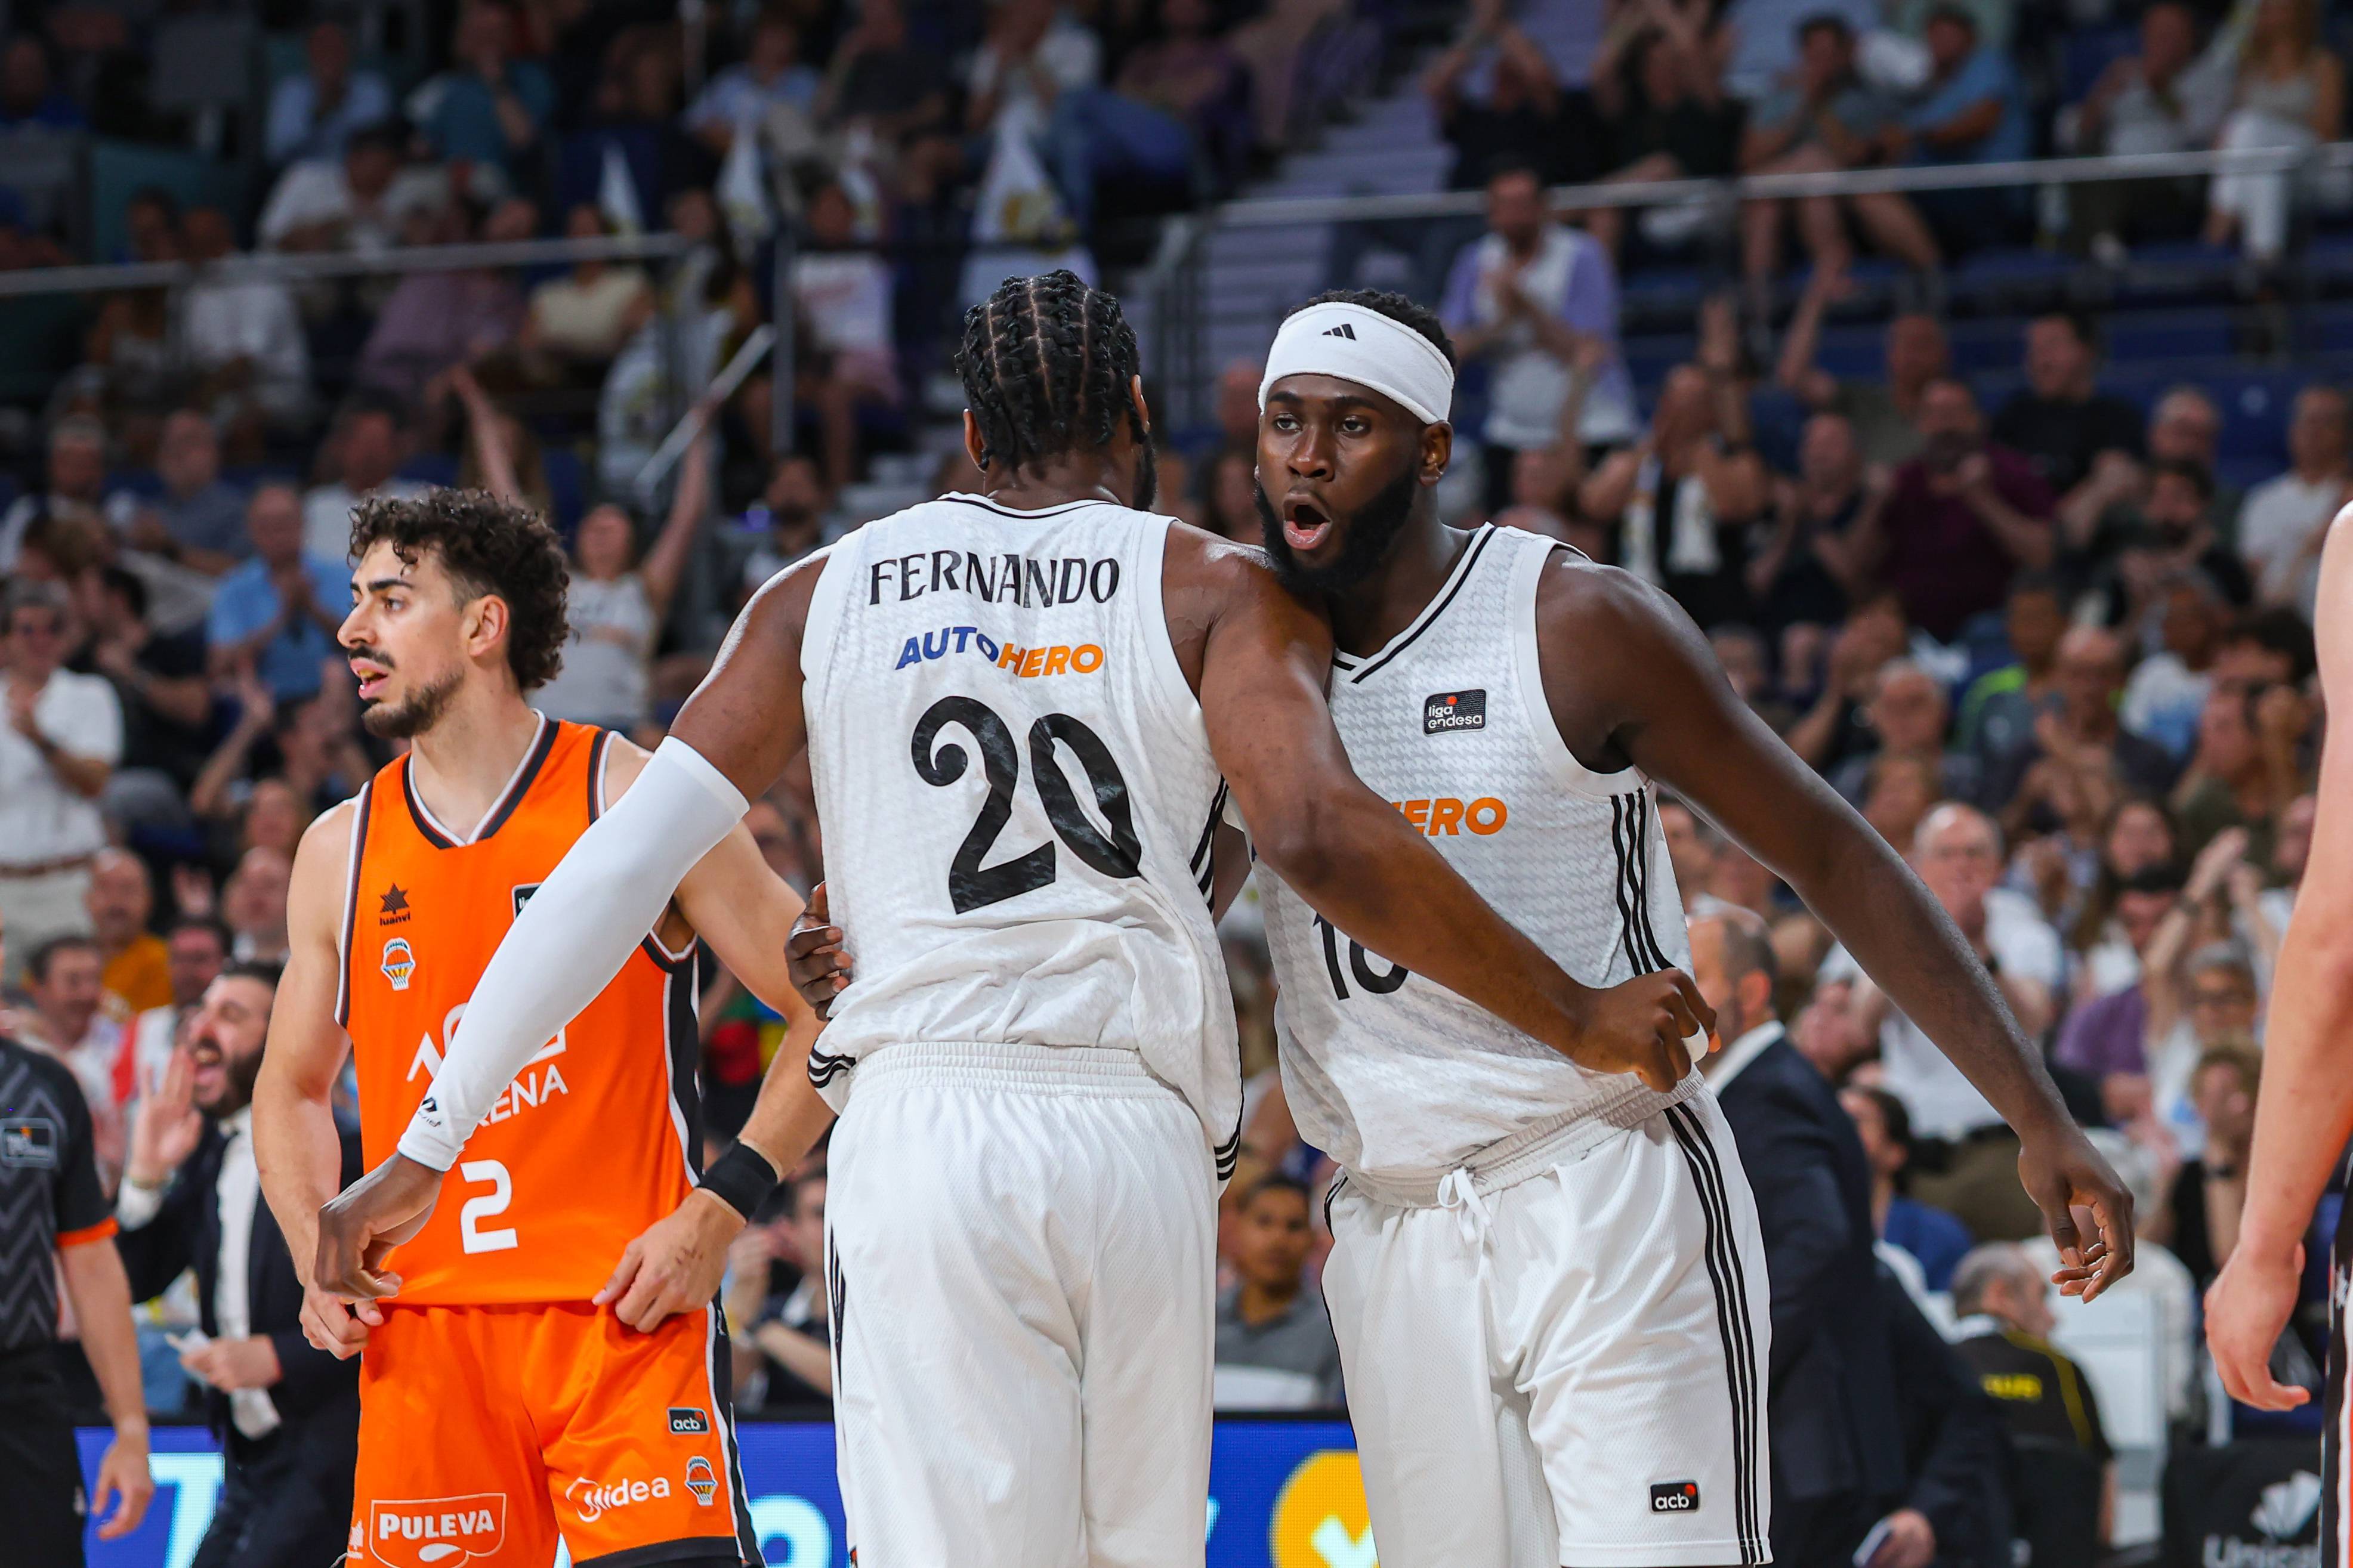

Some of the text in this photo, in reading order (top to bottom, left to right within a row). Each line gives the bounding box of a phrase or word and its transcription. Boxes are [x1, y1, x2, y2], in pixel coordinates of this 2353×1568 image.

[869, 550, 1120, 608] FERNANDO
[895, 626, 1104, 678] AUTOHERO
[1428, 705, 1453, 718] liga
[1428, 715, 1483, 729] endesa
[911, 695, 1142, 915] 20
[1391, 797, 1508, 836] ERO
[459, 1159, 518, 1255] 2
[672, 1418, 701, 1431] acb
[575, 1477, 671, 1519] Midea
[1654, 1492, 1690, 1510] acb
[379, 1509, 496, 1541] PULEVA
